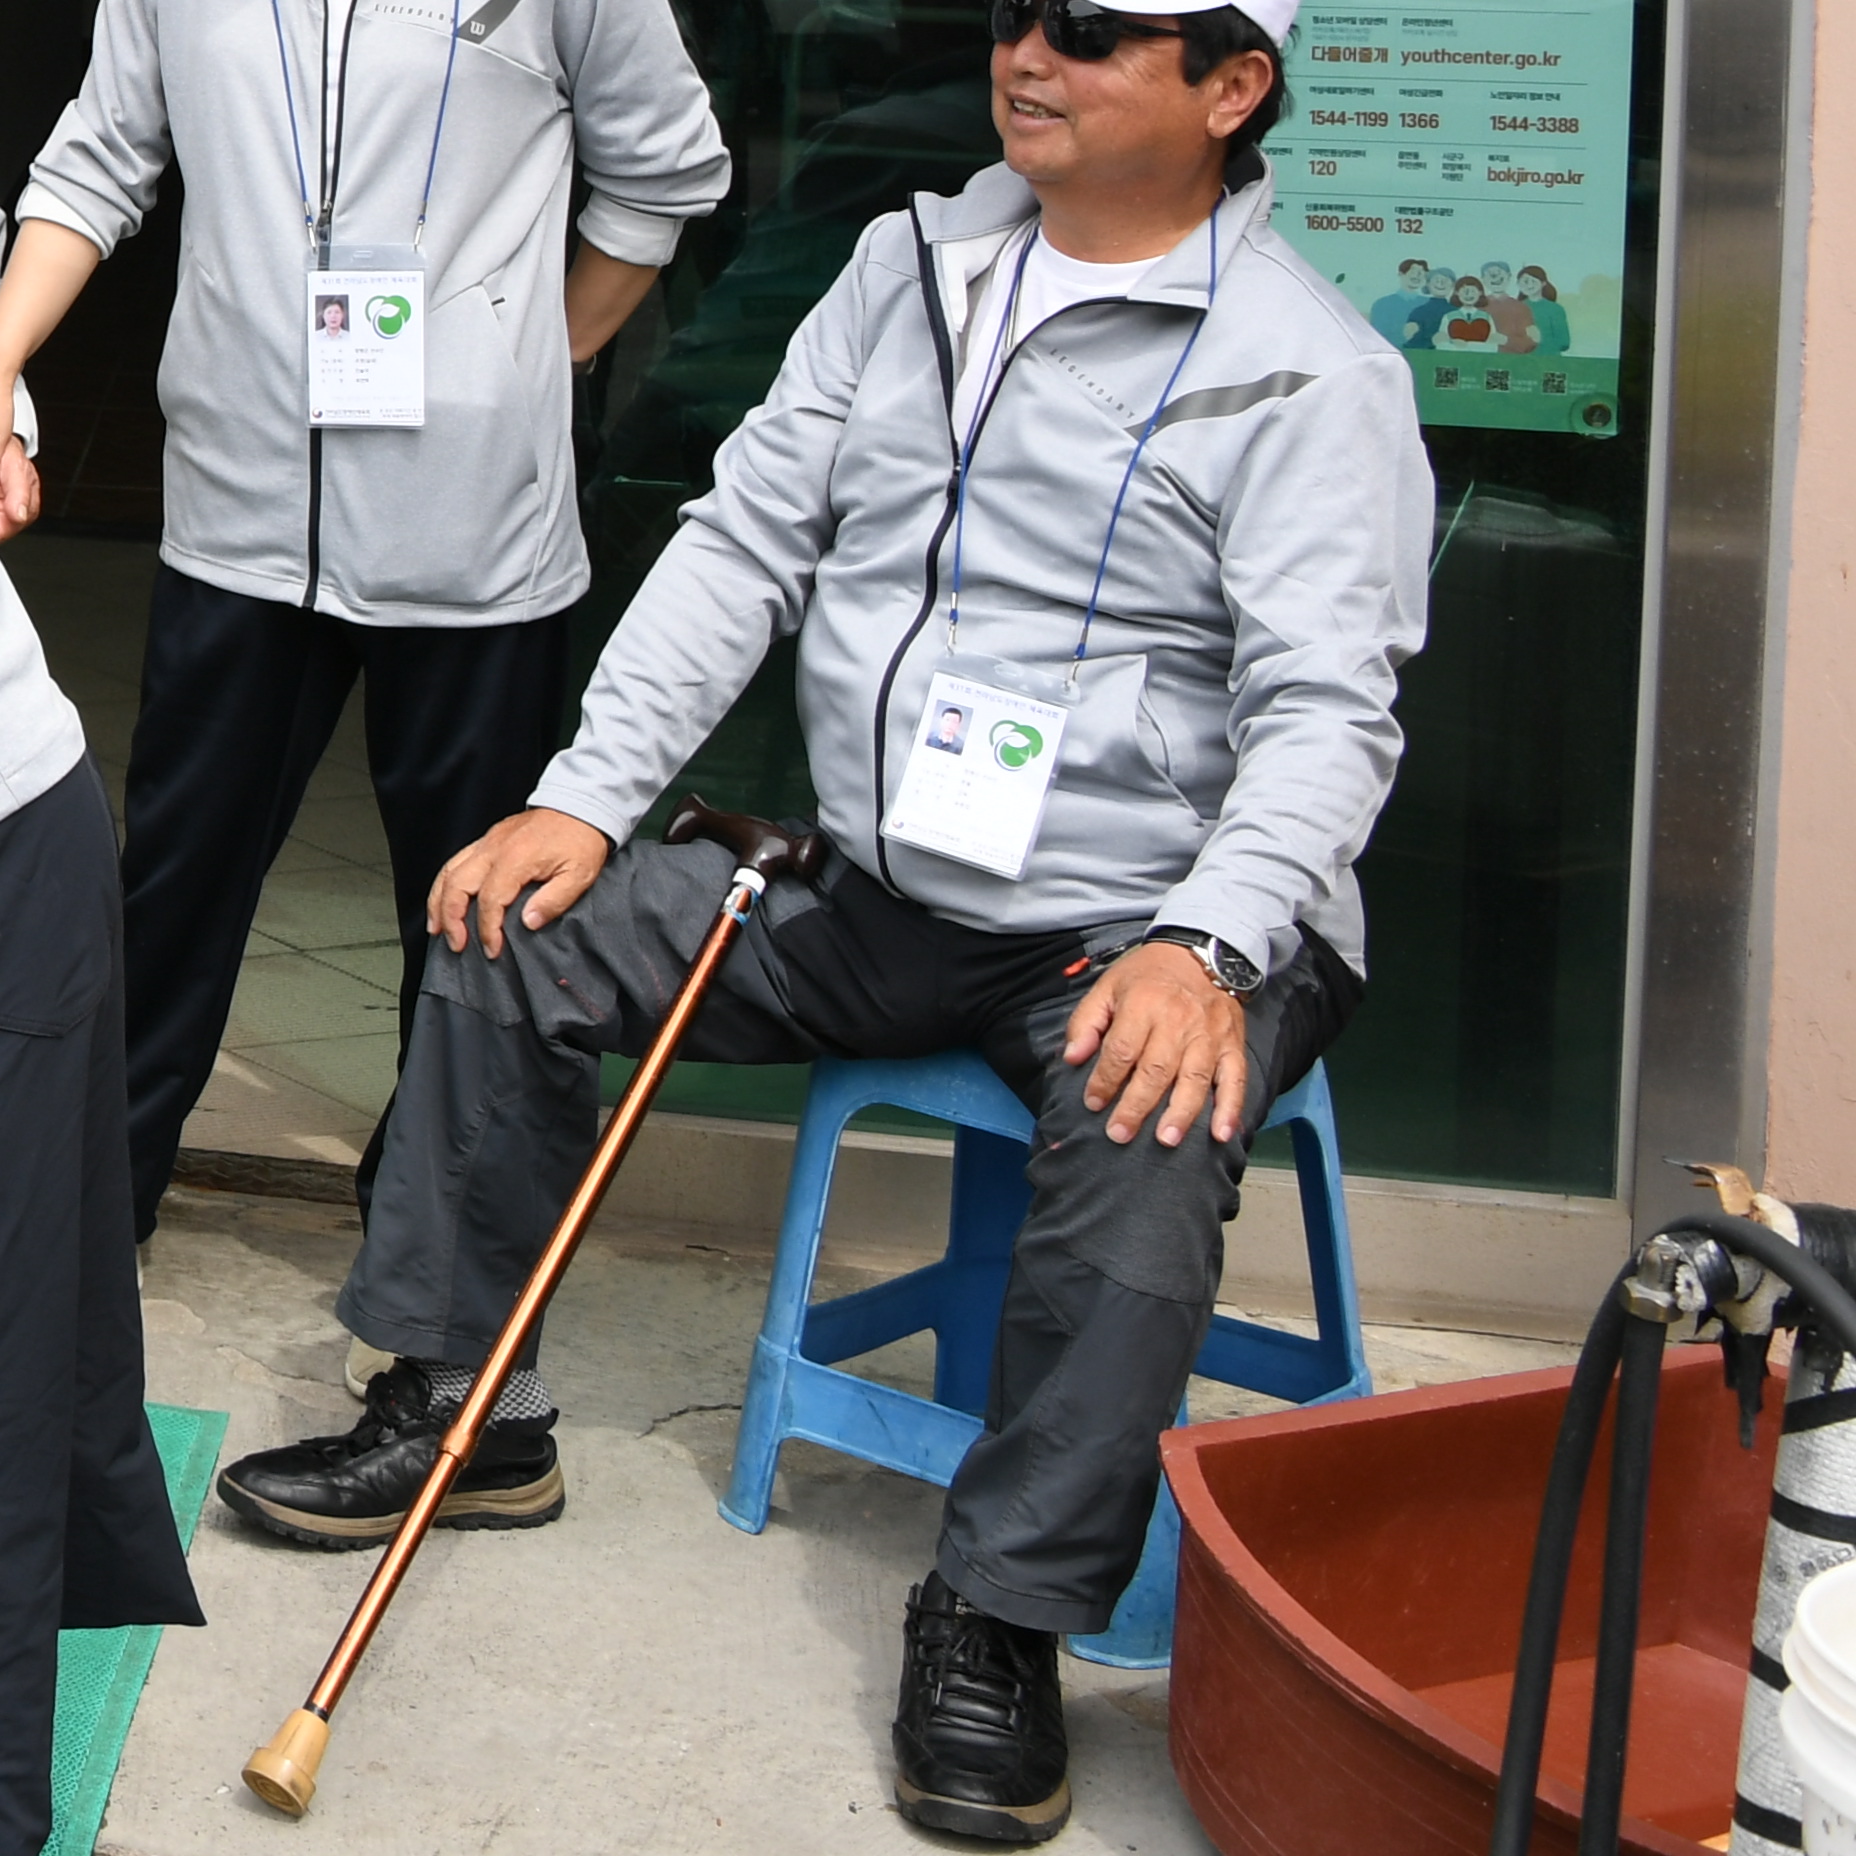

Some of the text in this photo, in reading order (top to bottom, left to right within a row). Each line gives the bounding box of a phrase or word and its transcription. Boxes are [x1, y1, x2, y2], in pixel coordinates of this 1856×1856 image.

[1401, 49, 1561, 69] youthcenter.go.kr
[1309, 110, 1388, 127] 1544-1199
[1398, 112, 1439, 129] 1366
[1489, 115, 1579, 133] 1544-3388
[1308, 160, 1337, 176] 120
[1487, 166, 1584, 188] bokjiro.go.kr
[1305, 215, 1384, 232] 1600-5500
[1395, 218, 1423, 234] 132
[1050, 349, 1135, 419] LEGENDARY
